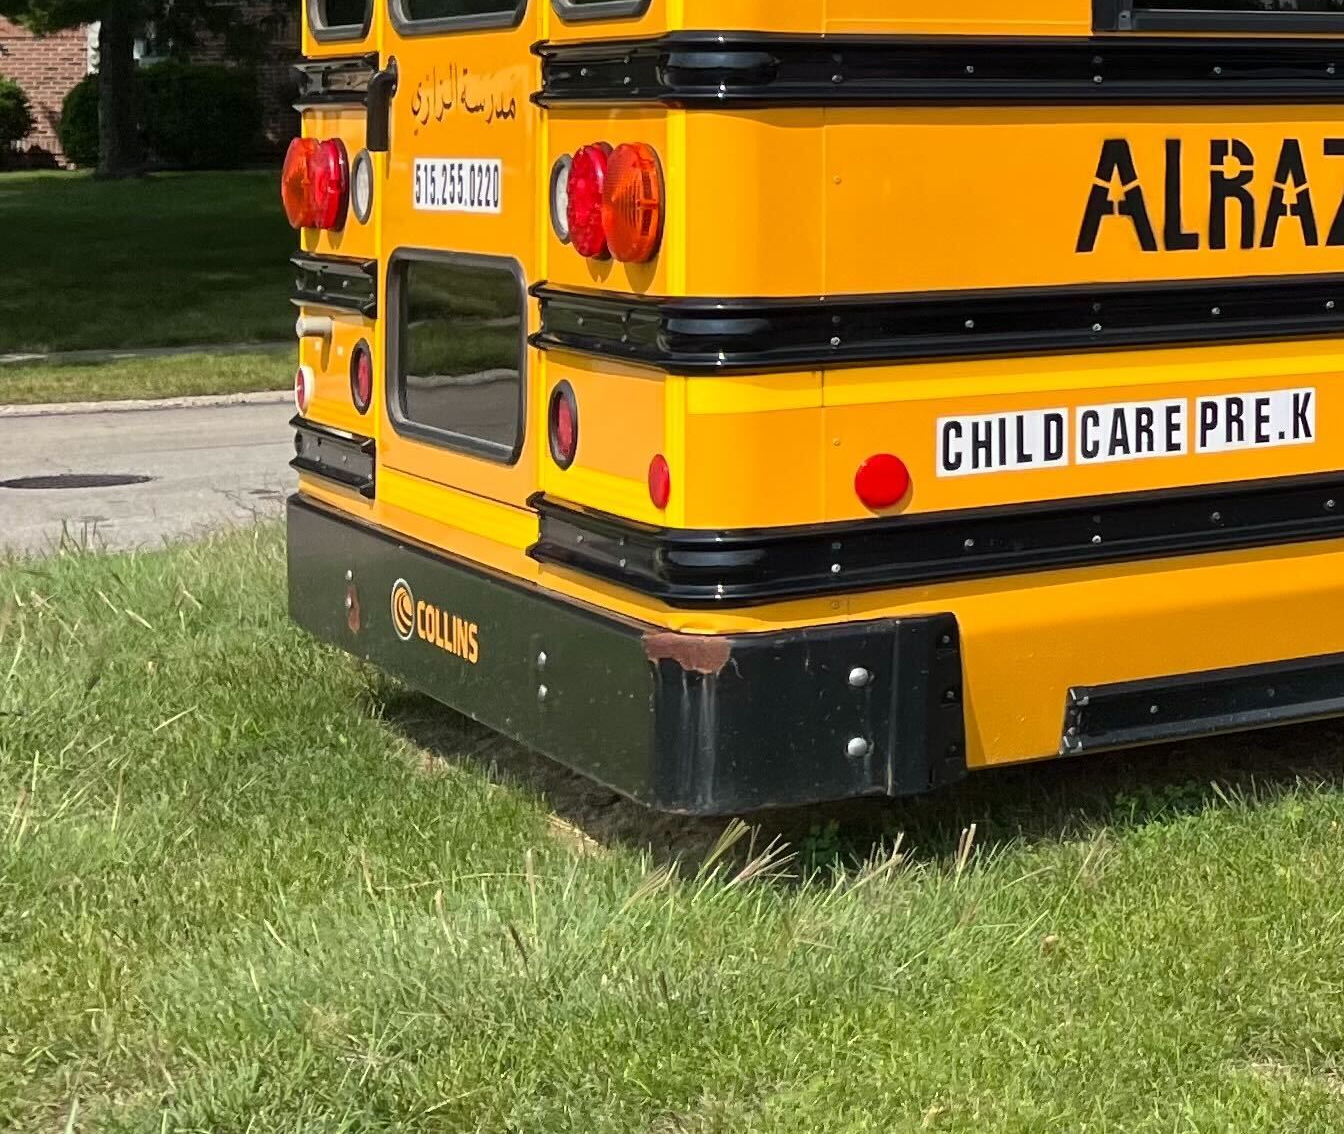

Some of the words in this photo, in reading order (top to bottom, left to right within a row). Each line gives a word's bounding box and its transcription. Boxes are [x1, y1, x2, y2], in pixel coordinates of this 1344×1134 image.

[415, 163, 499, 208] 515.255.0220
[942, 411, 1065, 471] CHILD
[1080, 404, 1182, 459] CARE
[1200, 391, 1313, 448] PRE.K
[416, 600, 479, 664] COLLINS
